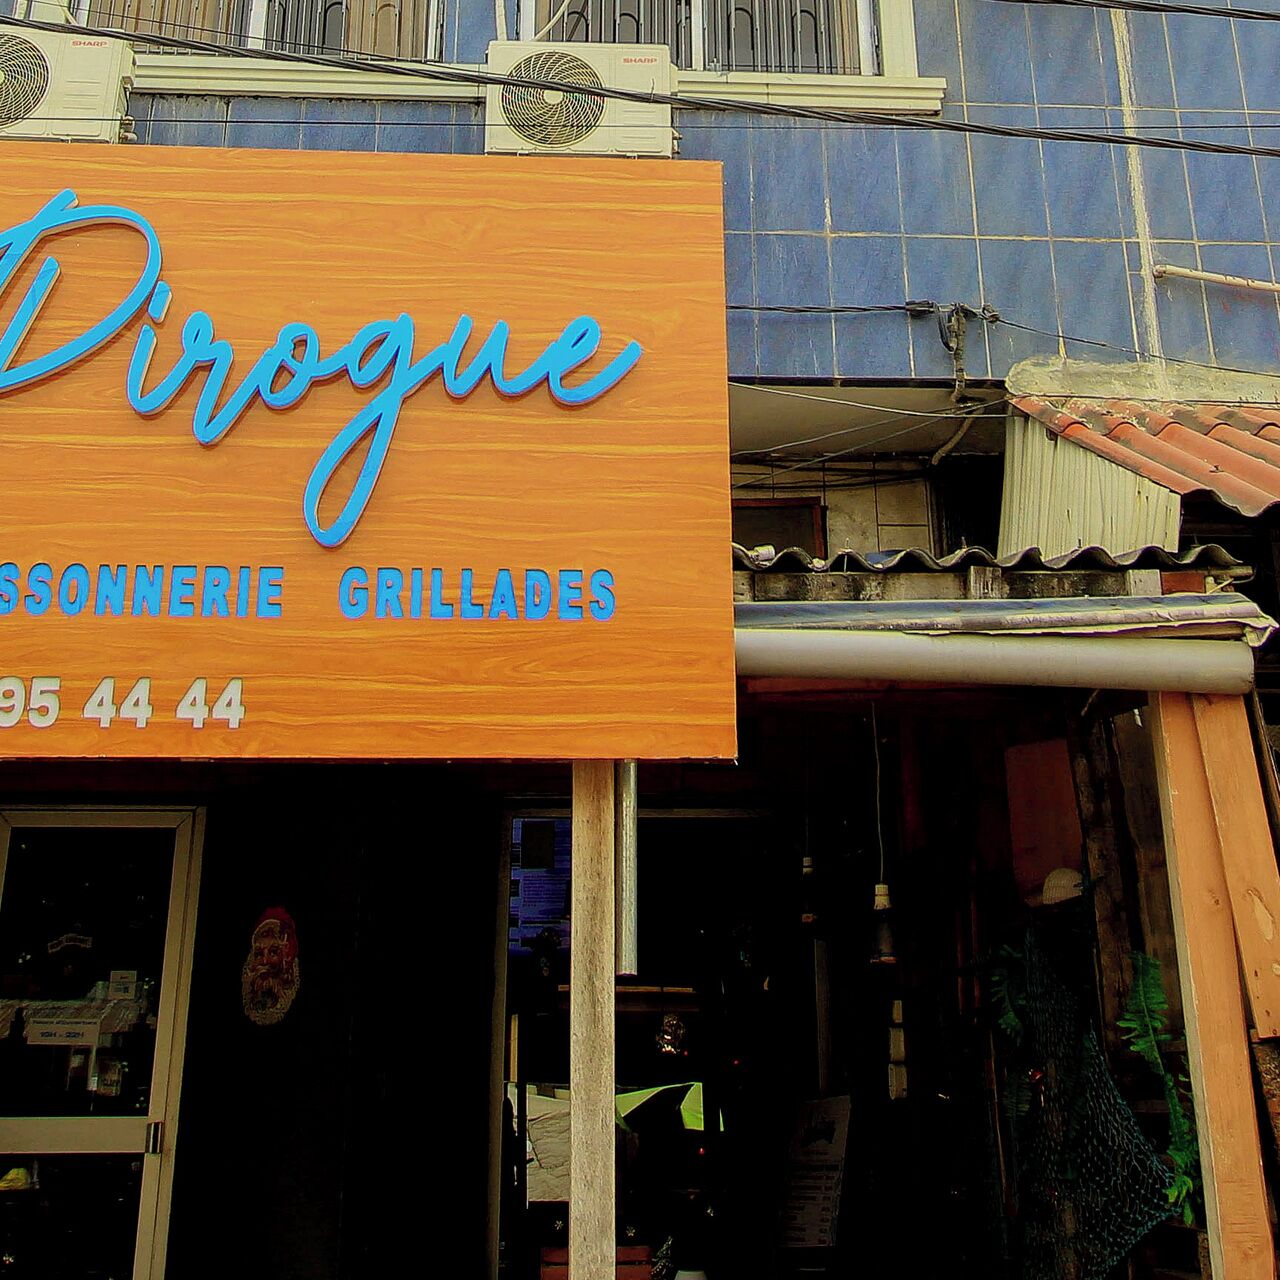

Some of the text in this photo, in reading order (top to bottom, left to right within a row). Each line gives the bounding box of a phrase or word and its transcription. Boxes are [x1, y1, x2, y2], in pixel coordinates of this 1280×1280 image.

[338, 566, 616, 621] GRILLADES
[82, 676, 153, 729] 44
[175, 676, 247, 729] 44
